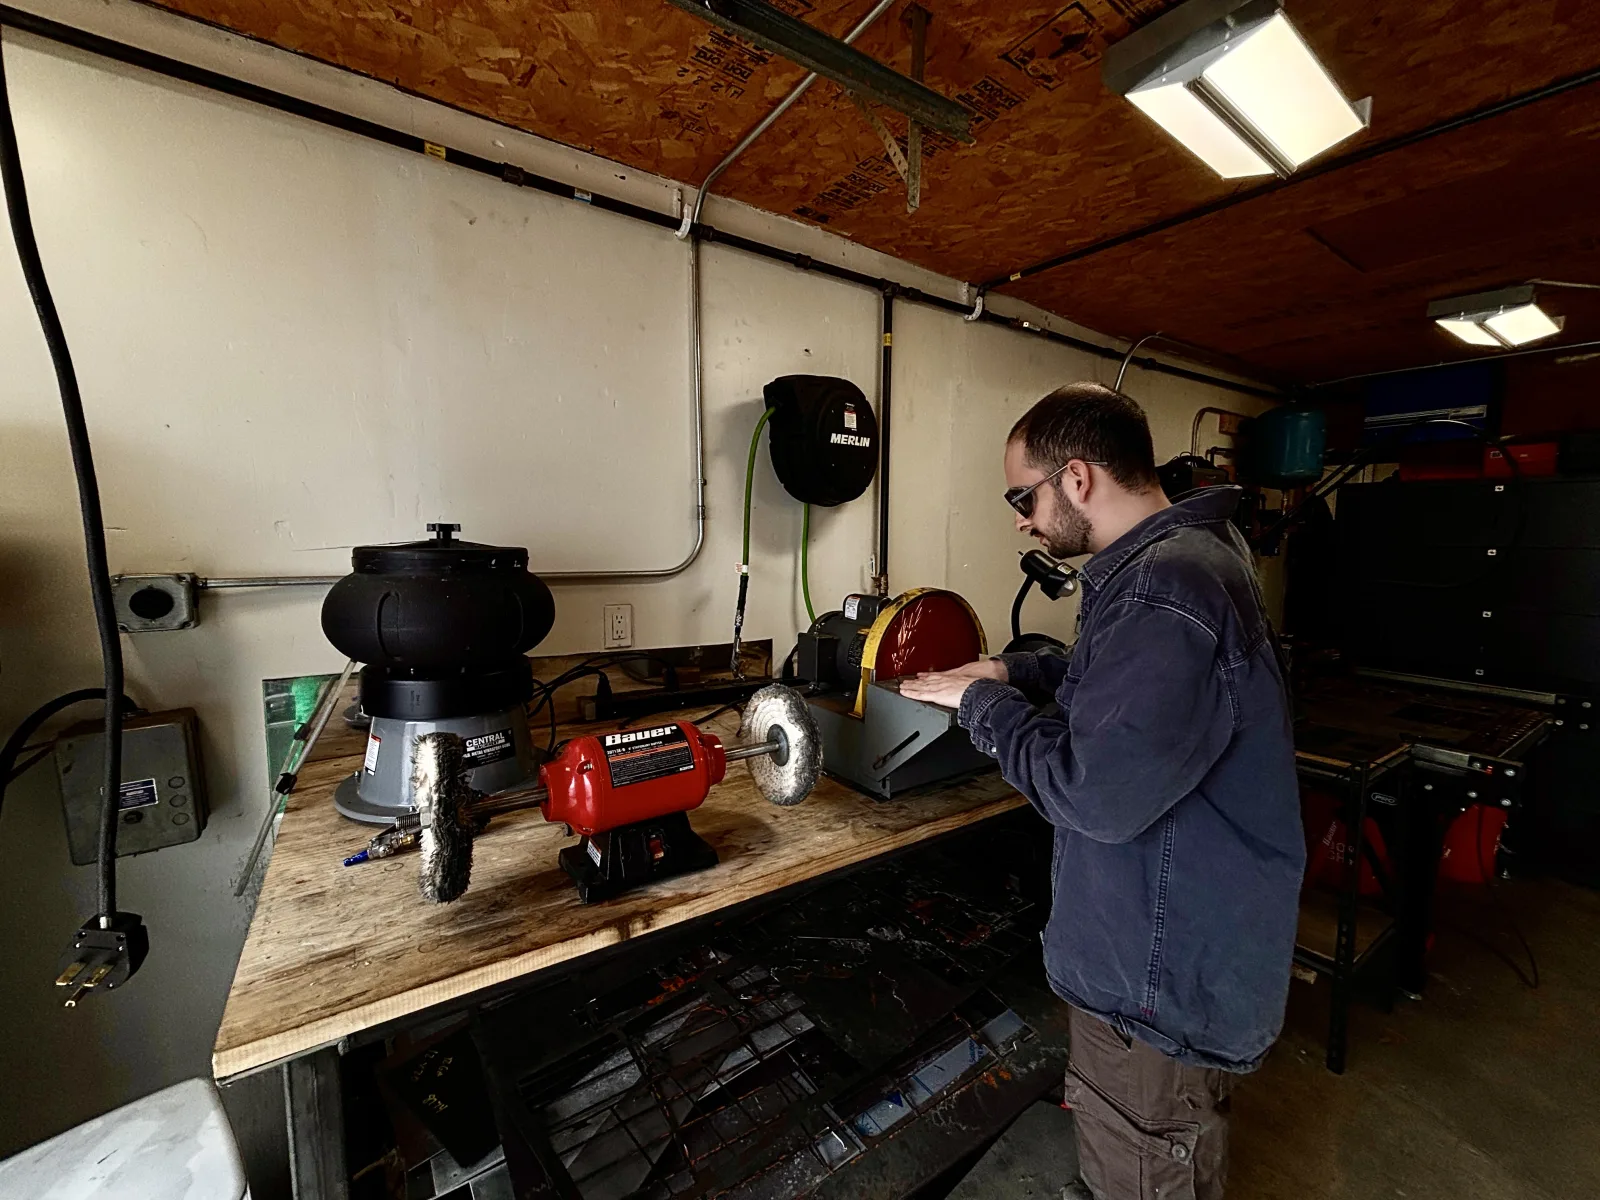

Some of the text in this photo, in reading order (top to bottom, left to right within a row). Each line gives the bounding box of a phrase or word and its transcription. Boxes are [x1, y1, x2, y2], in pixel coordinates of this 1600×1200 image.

[830, 433, 870, 447] MERLIN
[465, 732, 505, 747] CENTRAL
[605, 725, 677, 746] Bauer
